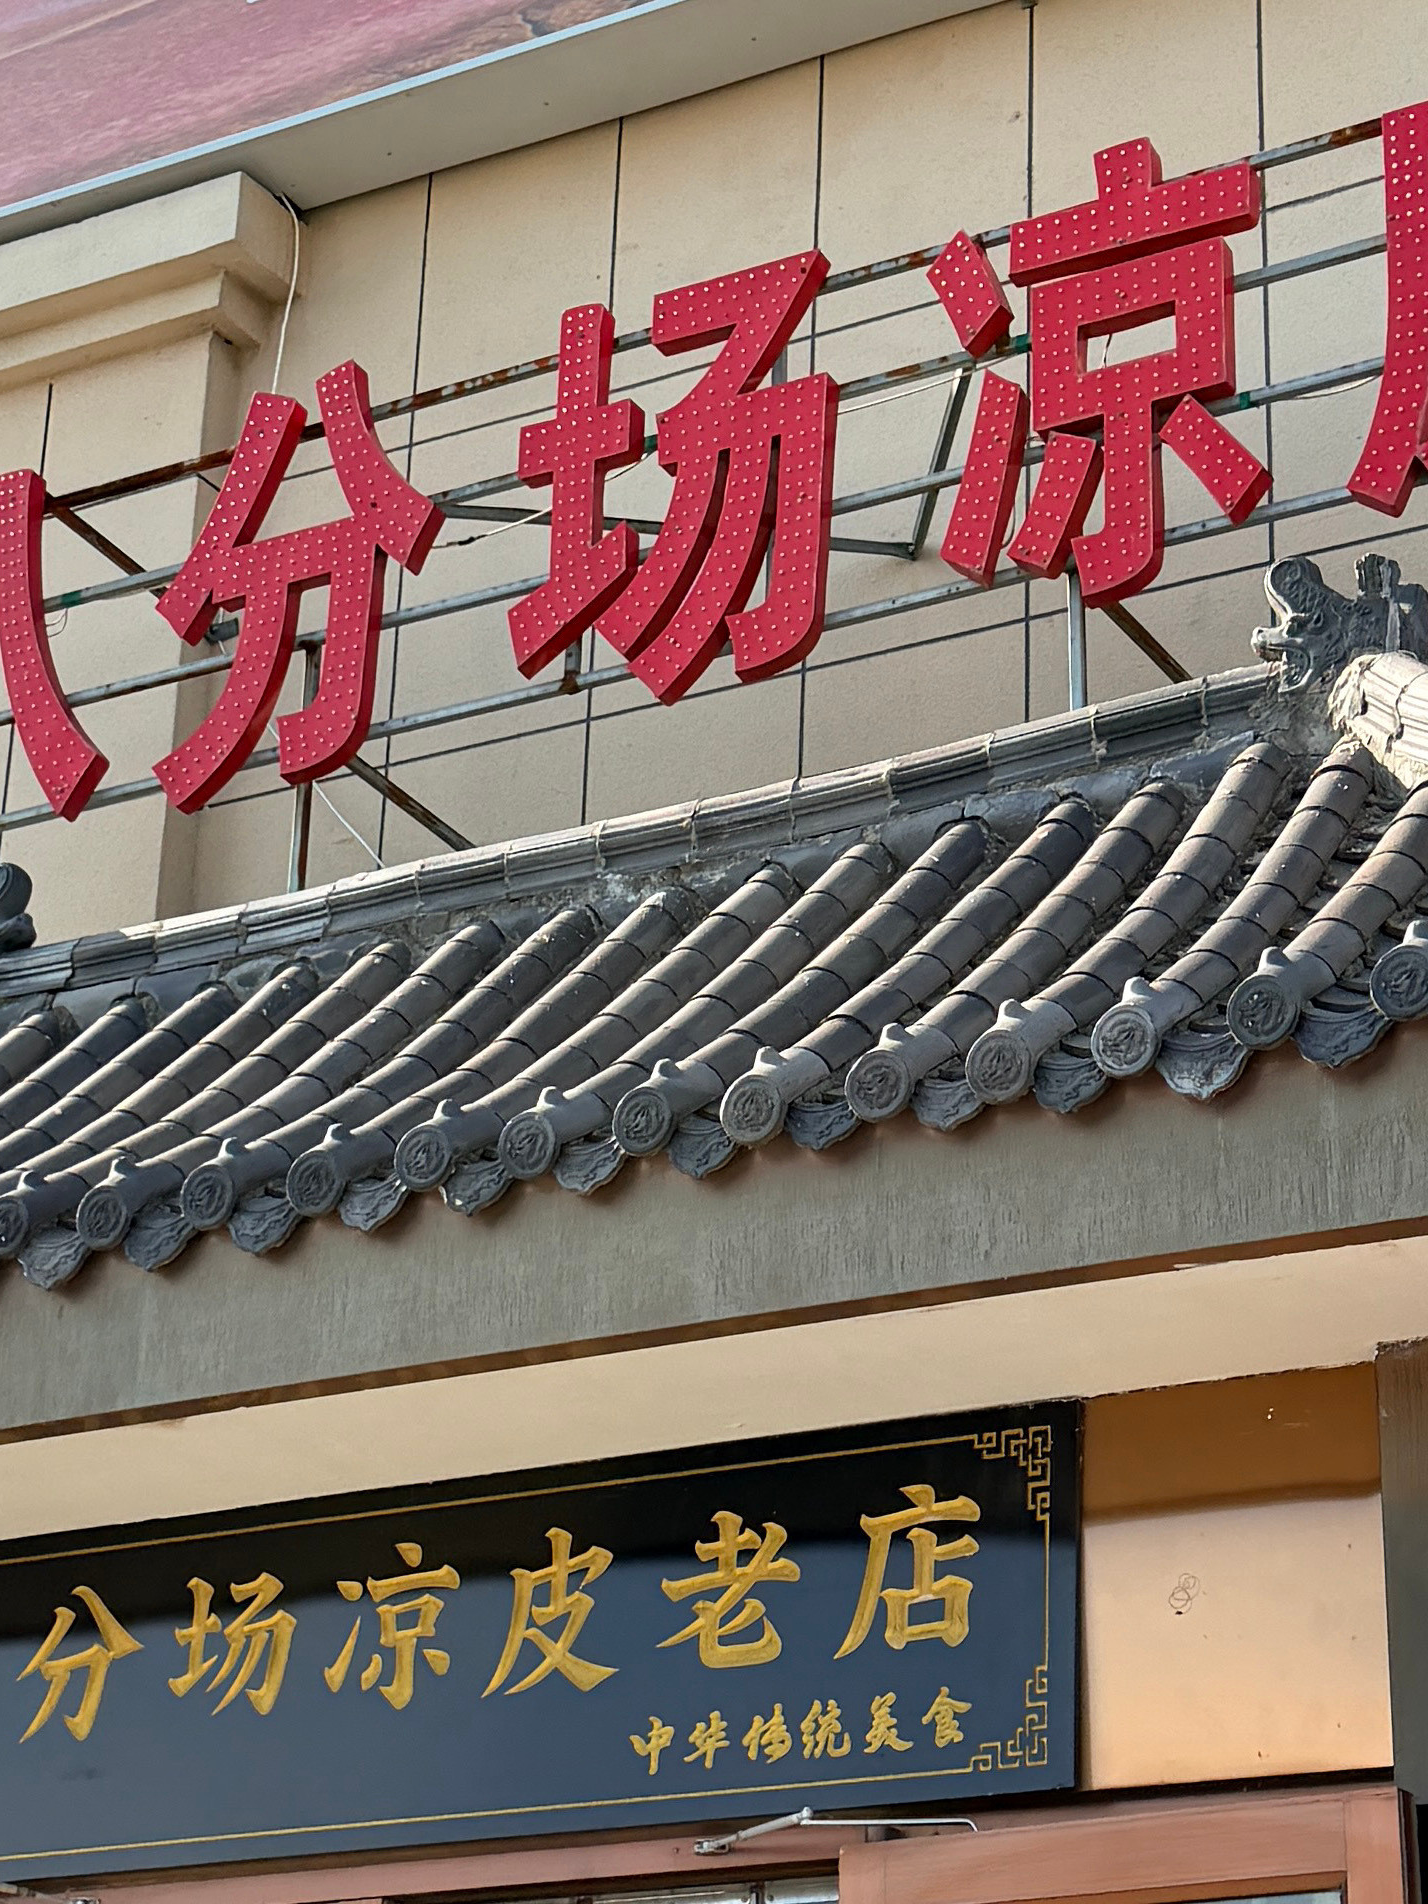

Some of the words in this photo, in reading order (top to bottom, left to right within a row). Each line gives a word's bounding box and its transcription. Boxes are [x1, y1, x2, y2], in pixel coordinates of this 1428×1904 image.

[629, 1685, 974, 1776] 中华传统美食
